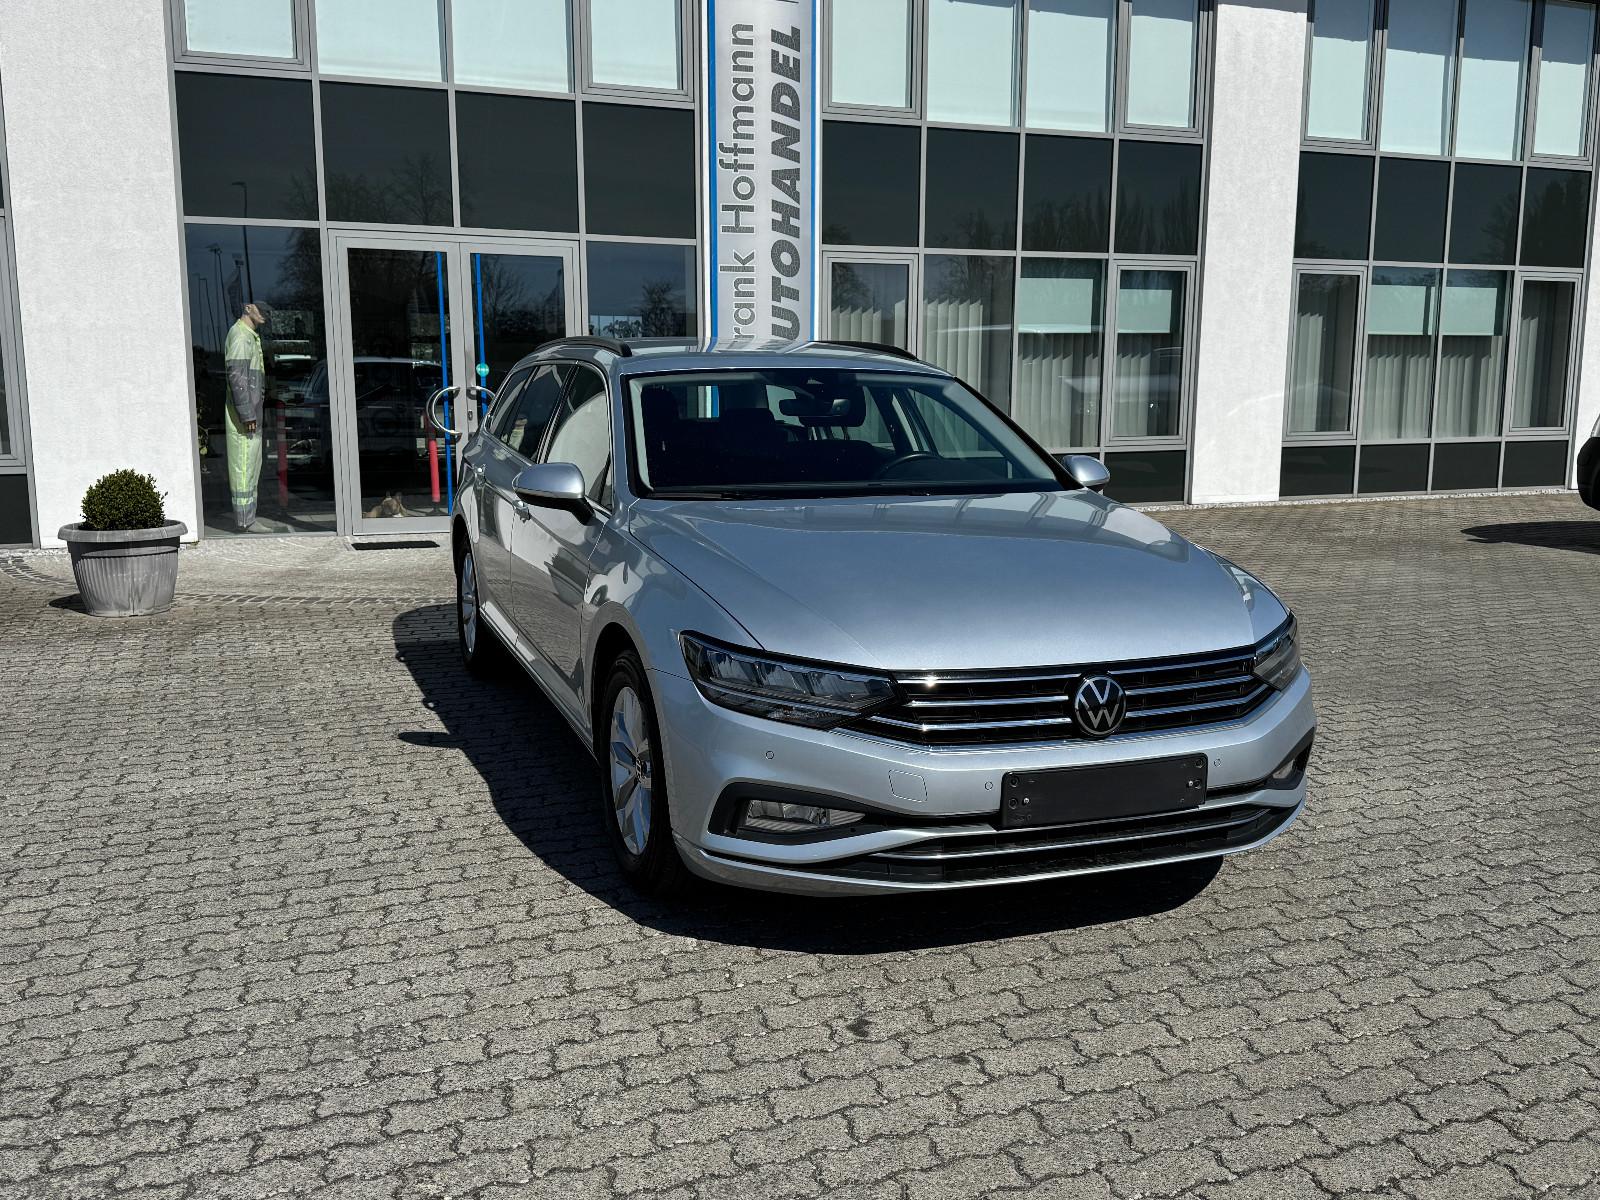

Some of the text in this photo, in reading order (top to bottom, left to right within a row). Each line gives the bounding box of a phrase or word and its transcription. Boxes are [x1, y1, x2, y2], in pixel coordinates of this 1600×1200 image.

[718, 23, 756, 340] rank Hoffmann
[770, 25, 801, 341] UTOHANDEL
